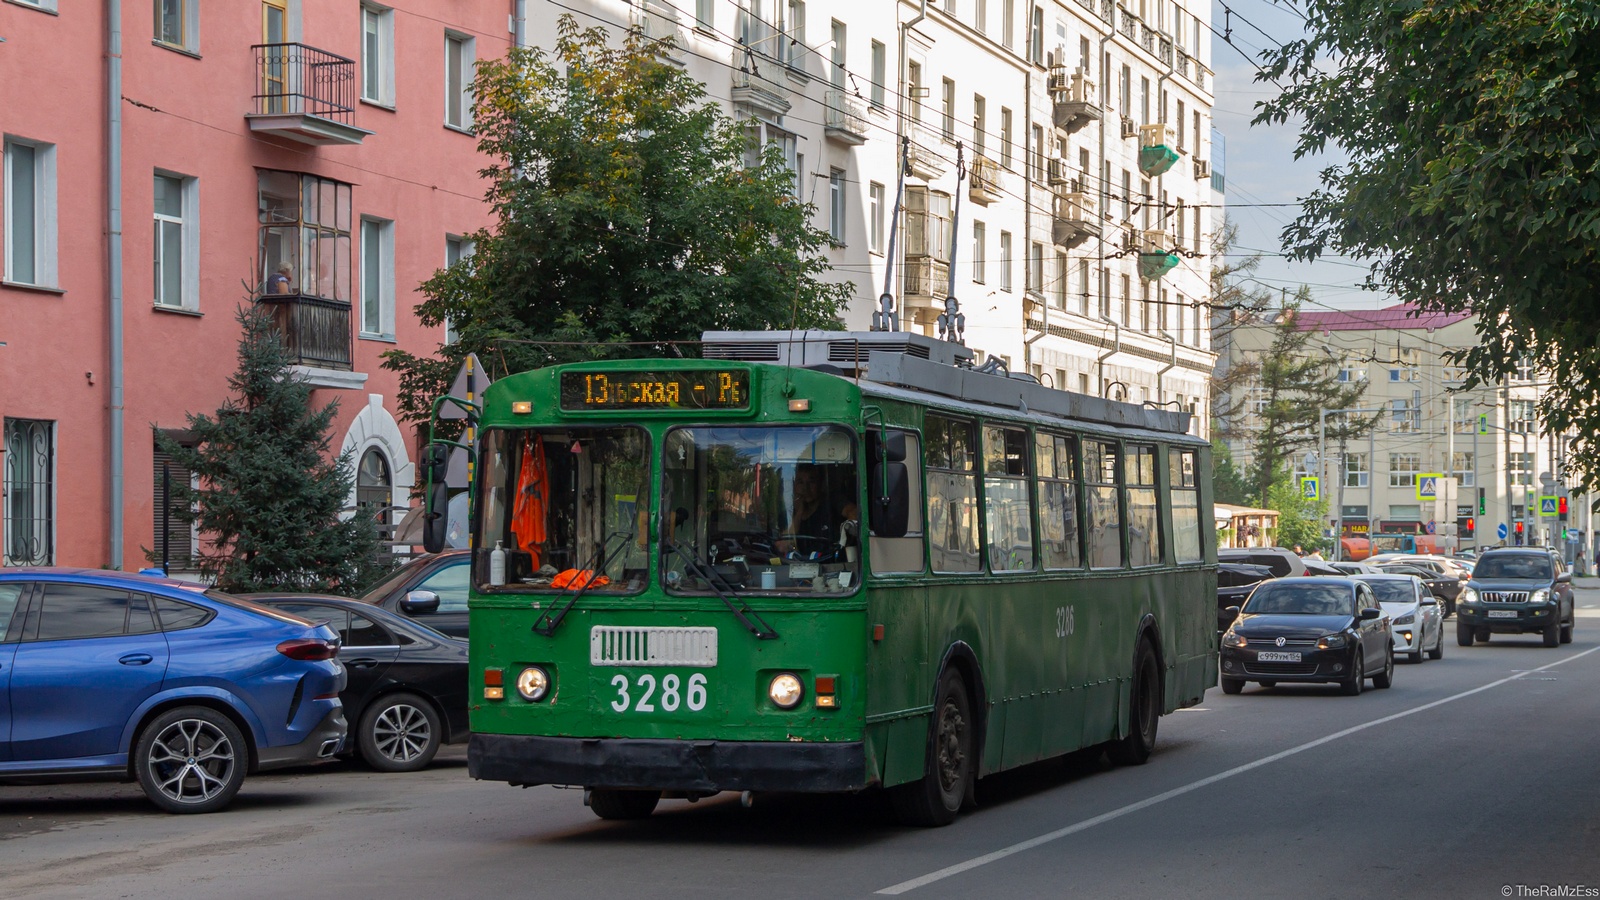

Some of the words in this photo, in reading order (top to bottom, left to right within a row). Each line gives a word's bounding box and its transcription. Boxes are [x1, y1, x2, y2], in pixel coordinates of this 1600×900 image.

[585, 374, 608, 403] 13
[1056, 604, 1075, 638] 3286
[610, 672, 708, 713] 3286
